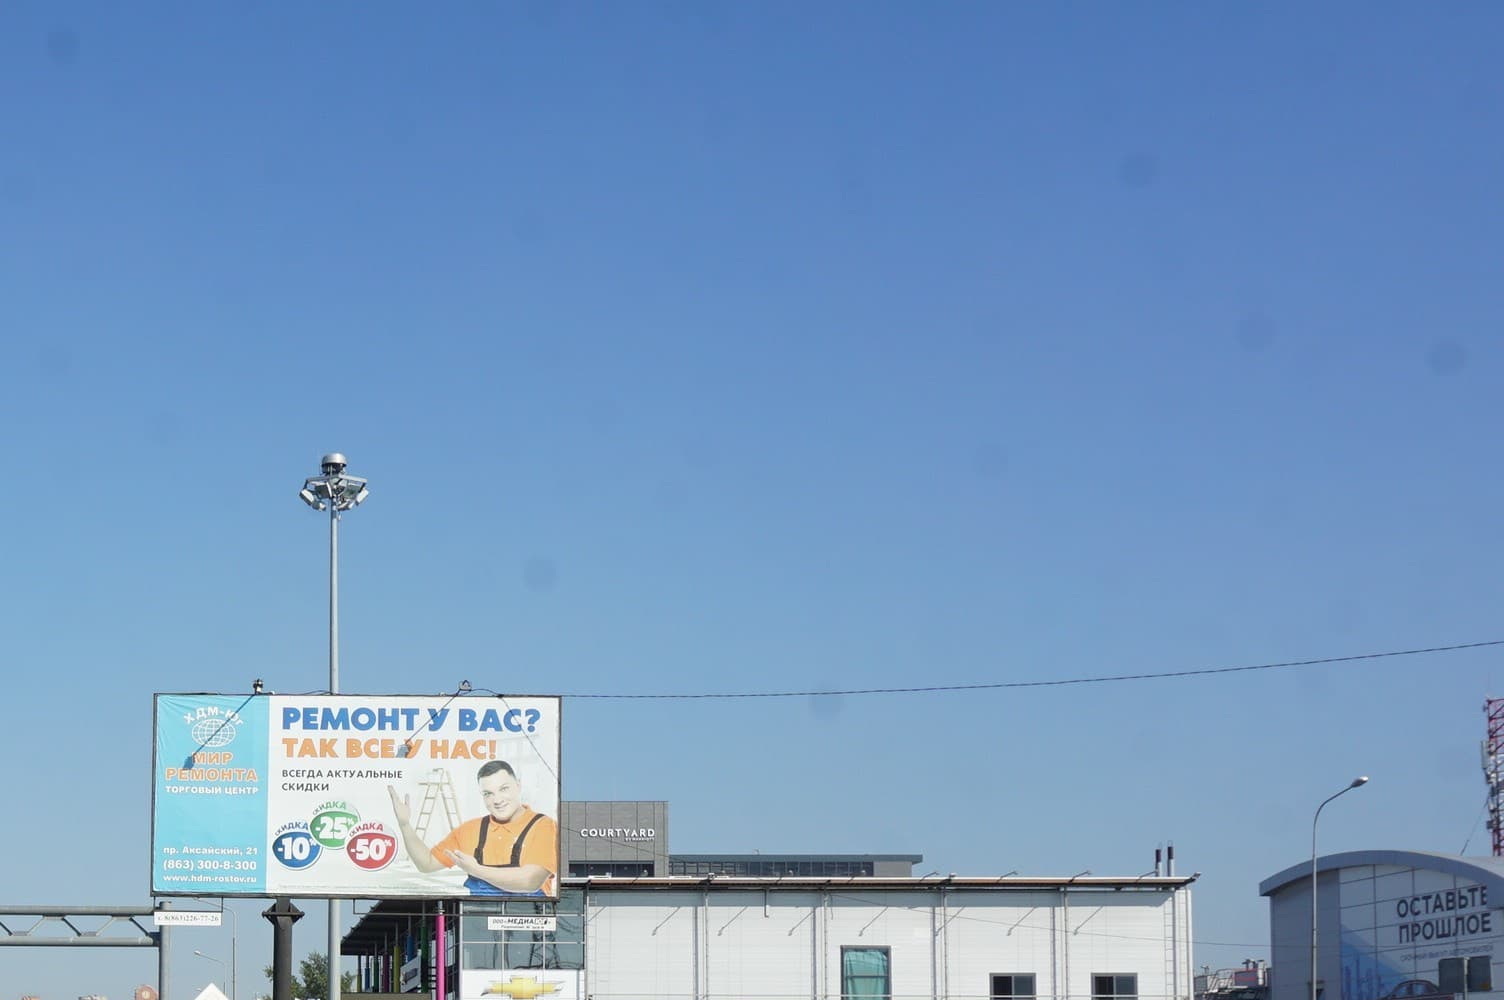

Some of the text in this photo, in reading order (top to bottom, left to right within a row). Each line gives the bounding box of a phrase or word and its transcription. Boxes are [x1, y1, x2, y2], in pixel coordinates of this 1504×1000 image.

[282, 707, 541, 732] РЕМОНТ У ВАС?
[282, 738, 497, 760] ТАК ВСЕ У НАС!
[192, 752, 233, 765] МИР
[165, 768, 258, 781] РЕМОНТА
[282, 769, 403, 779] ВСЕГДА АКТУАЛЬНЫЕ
[166, 785, 259, 796] ТОРГОВЫЙ ЦЕНТР
[282, 782, 329, 792] СКИДКИ
[312, 801, 347, 816] СКИДКА
[275, 822, 309, 837] СКИДКА
[349, 823, 384, 838] СКИДКА
[580, 828, 655, 838] COURTYARD
[163, 860, 257, 871] (863) 300-8-300
[1397, 885, 1488, 918] ОСТАВЬТЕ
[1399, 912, 1492, 944] ПРОШЛОЕ
